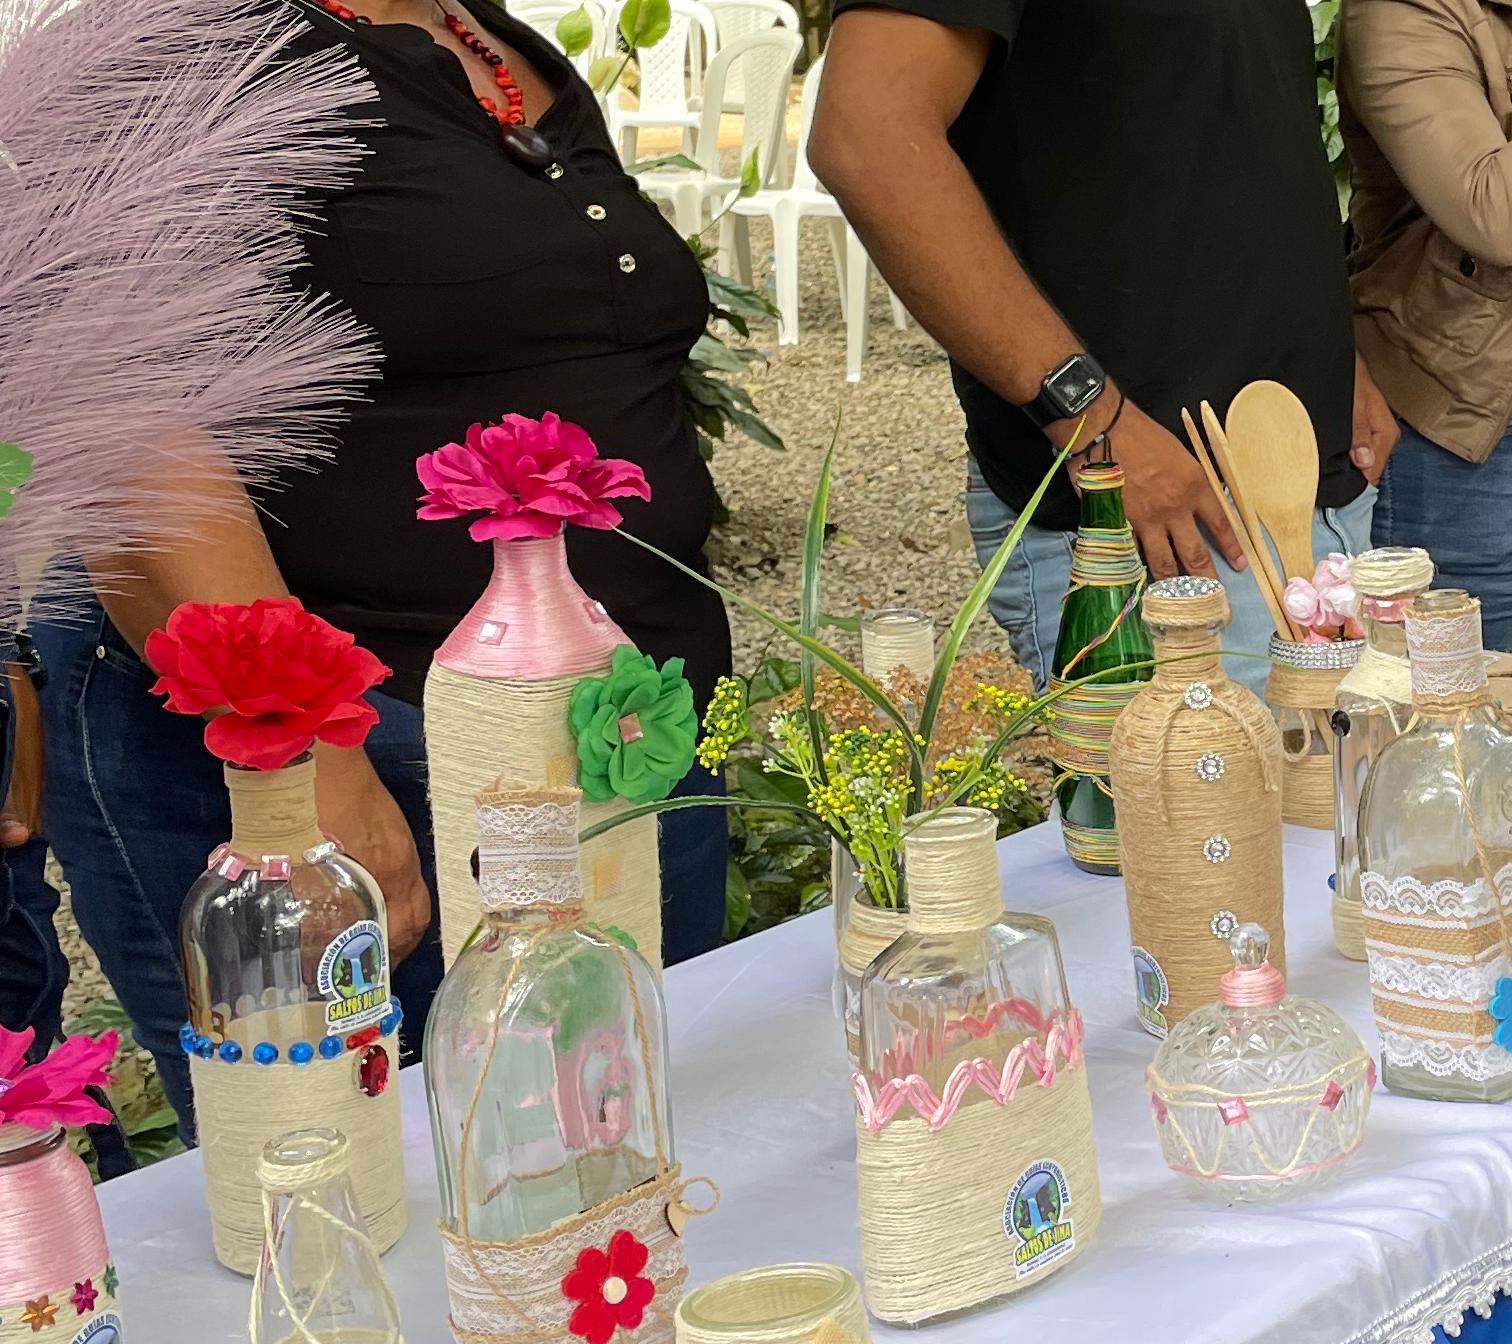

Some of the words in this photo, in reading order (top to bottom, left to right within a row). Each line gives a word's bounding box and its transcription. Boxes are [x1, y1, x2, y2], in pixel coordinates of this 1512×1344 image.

[329, 996, 363, 1021] SALTOS
[1015, 1233, 1045, 1266] SALTOS
[1043, 1229, 1054, 1251] DE
[1053, 1222, 1071, 1246] JIMA
